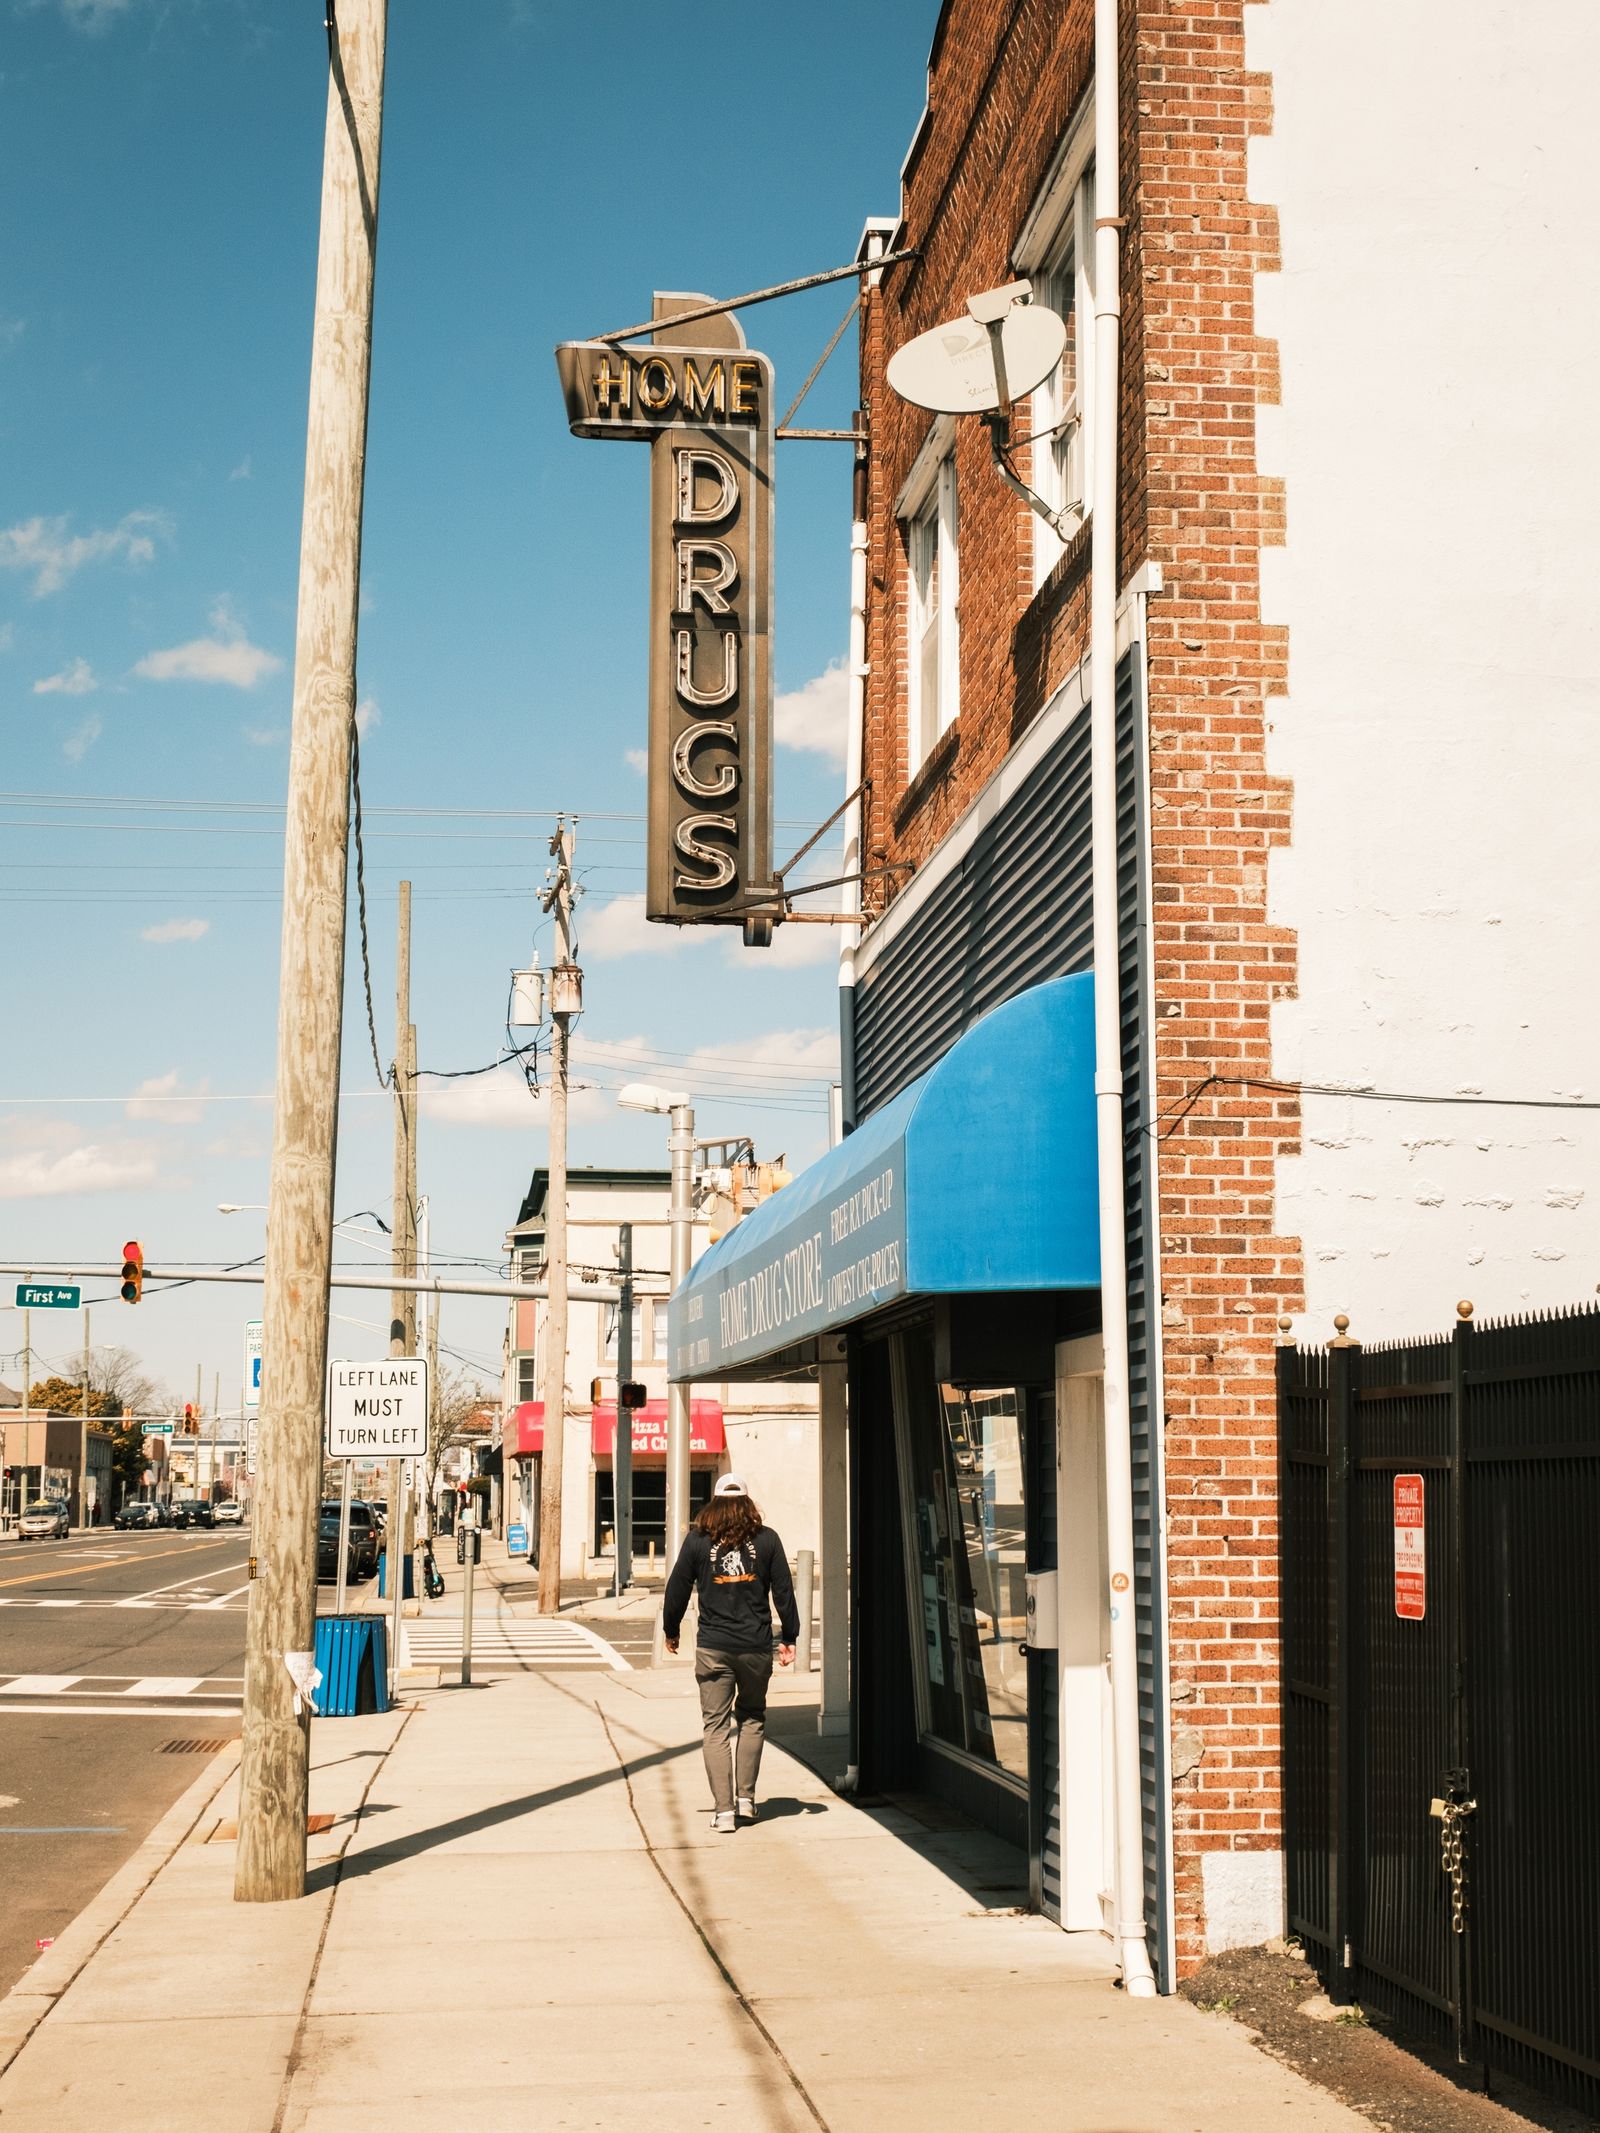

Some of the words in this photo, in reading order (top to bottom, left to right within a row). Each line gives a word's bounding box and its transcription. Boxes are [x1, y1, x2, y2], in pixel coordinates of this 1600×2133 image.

[594, 353, 761, 414] HOME
[673, 449, 740, 891] DRUGS
[831, 1202, 849, 1246] FREE
[849, 1192, 861, 1234] RX
[862, 1168, 893, 1226] PICK-UP
[827, 1265, 856, 1313] LOWEST
[871, 1240, 900, 1289] PRICES
[25, 1289, 54, 1304] First
[57, 1290, 72, 1300] Ave
[720, 1280, 749, 1349] HOME
[750, 1260, 782, 1337] DRUG
[784, 1231, 824, 1322] STORE
[339, 1371, 374, 1386] LEFT
[380, 1371, 418, 1386] LANE
[354, 1398, 403, 1416] MUST
[338, 1429, 377, 1444] TURN
[383, 1428, 418, 1443] LEFT
[651, 1436, 707, 1450] Chen
[1399, 1487, 1419, 1504] PRIVATE
[1396, 1506, 1422, 1523] PROPERTY
[1404, 1531, 1414, 1549] NO
